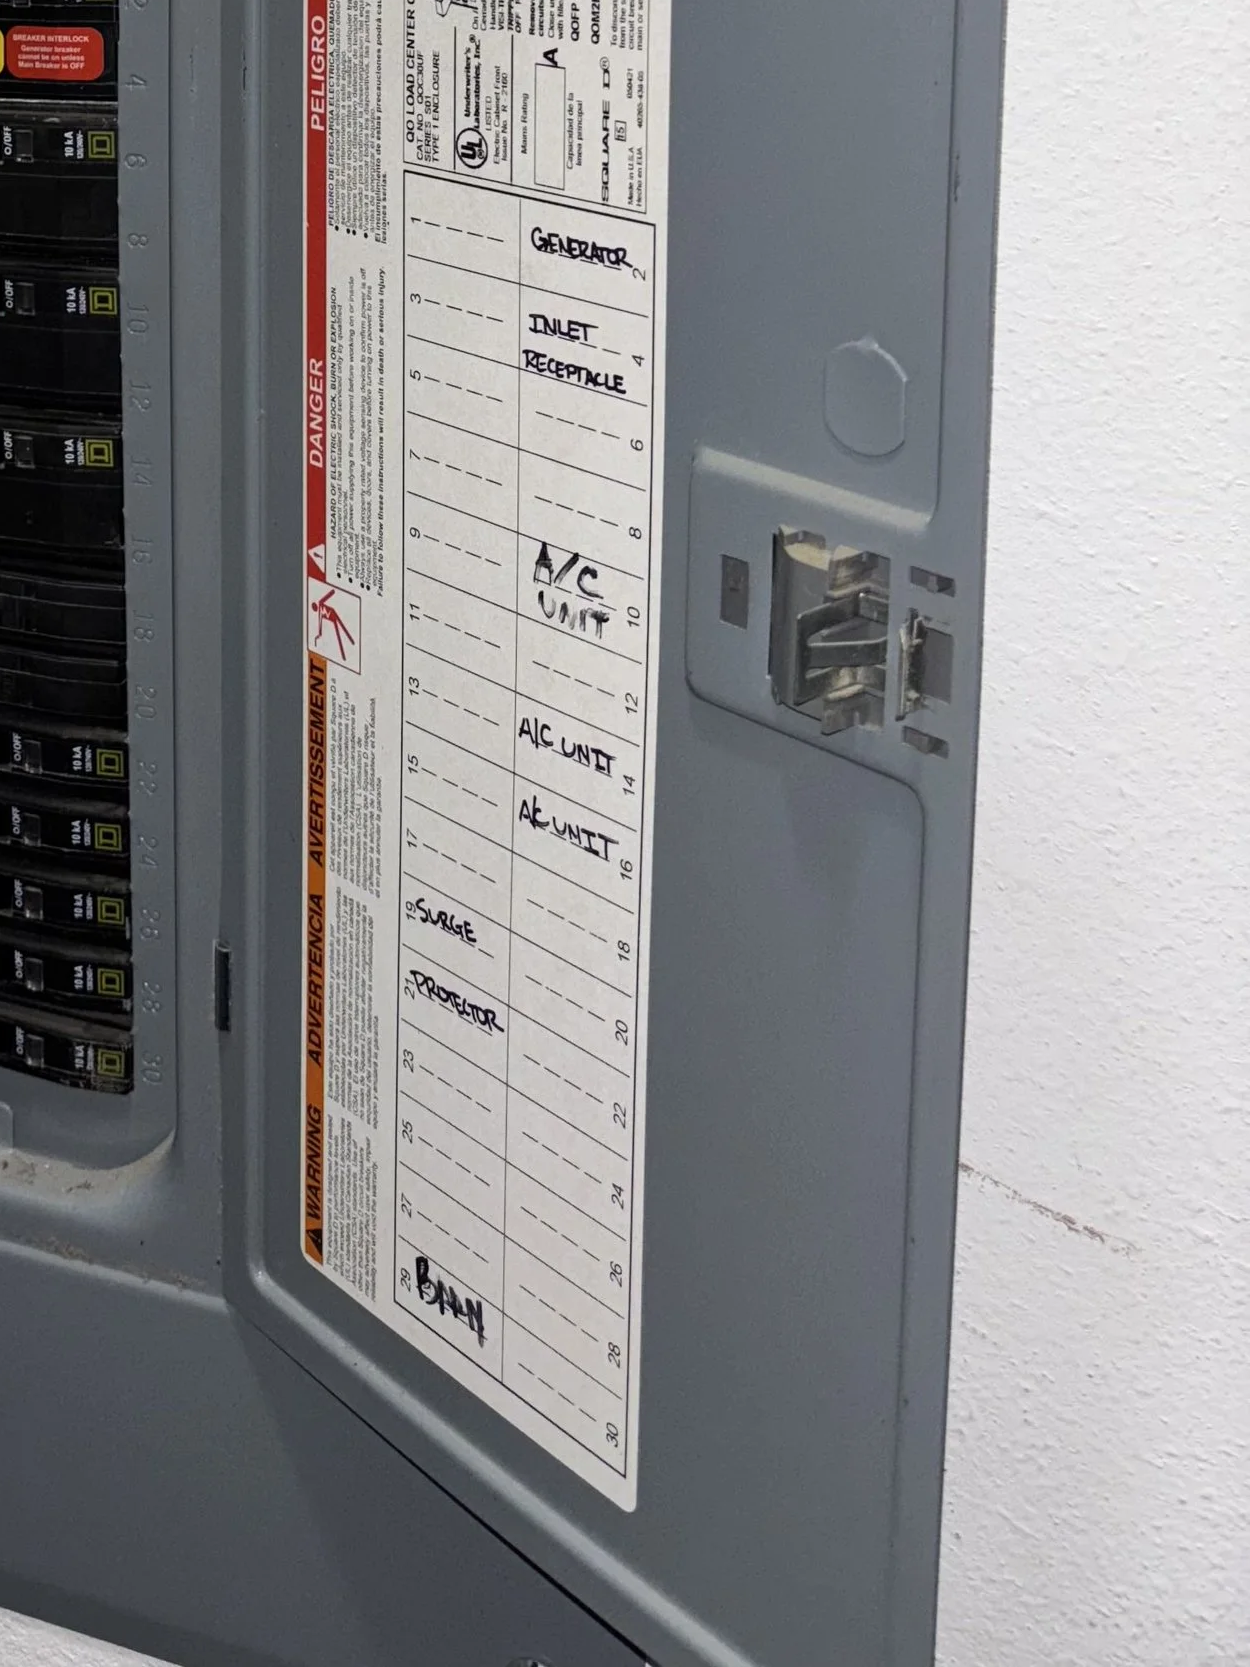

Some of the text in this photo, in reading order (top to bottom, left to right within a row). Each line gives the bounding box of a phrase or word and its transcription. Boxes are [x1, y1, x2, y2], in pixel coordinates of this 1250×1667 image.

[13, 34, 89, 43] BREAKER INTERLOCK
[21, 45, 52, 53] Generator
[405, 8, 416, 70] CENTER
[18, 61, 34, 69] Main
[70, 62, 85, 70] OFF
[311, 15, 325, 132] PELIGRO
[404, 73, 416, 116] LOAD
[403, 119, 416, 144] QO
[531, 227, 633, 268] GENERATOR
[632, 268, 646, 281] 2
[529, 313, 598, 341] INLET
[522, 349, 626, 394] RECEPTACLE
[632, 355, 645, 367] 4
[310, 358, 324, 468] DANGER
[629, 527, 641, 539] 8
[534, 542, 604, 599] A/C
[538, 590, 609, 639] UNIT
[627, 606, 640, 627] 10
[308, 659, 325, 867] AVERTISSEMENT
[561, 737, 617, 774] UNIT
[552, 816, 619, 861] UNIT
[416, 898, 476, 942] SURGE
[307, 892, 323, 1067] ADVERTENCIA
[410, 970, 504, 1032] PROTECTOR
[306, 1104, 322, 1222] WARNING
